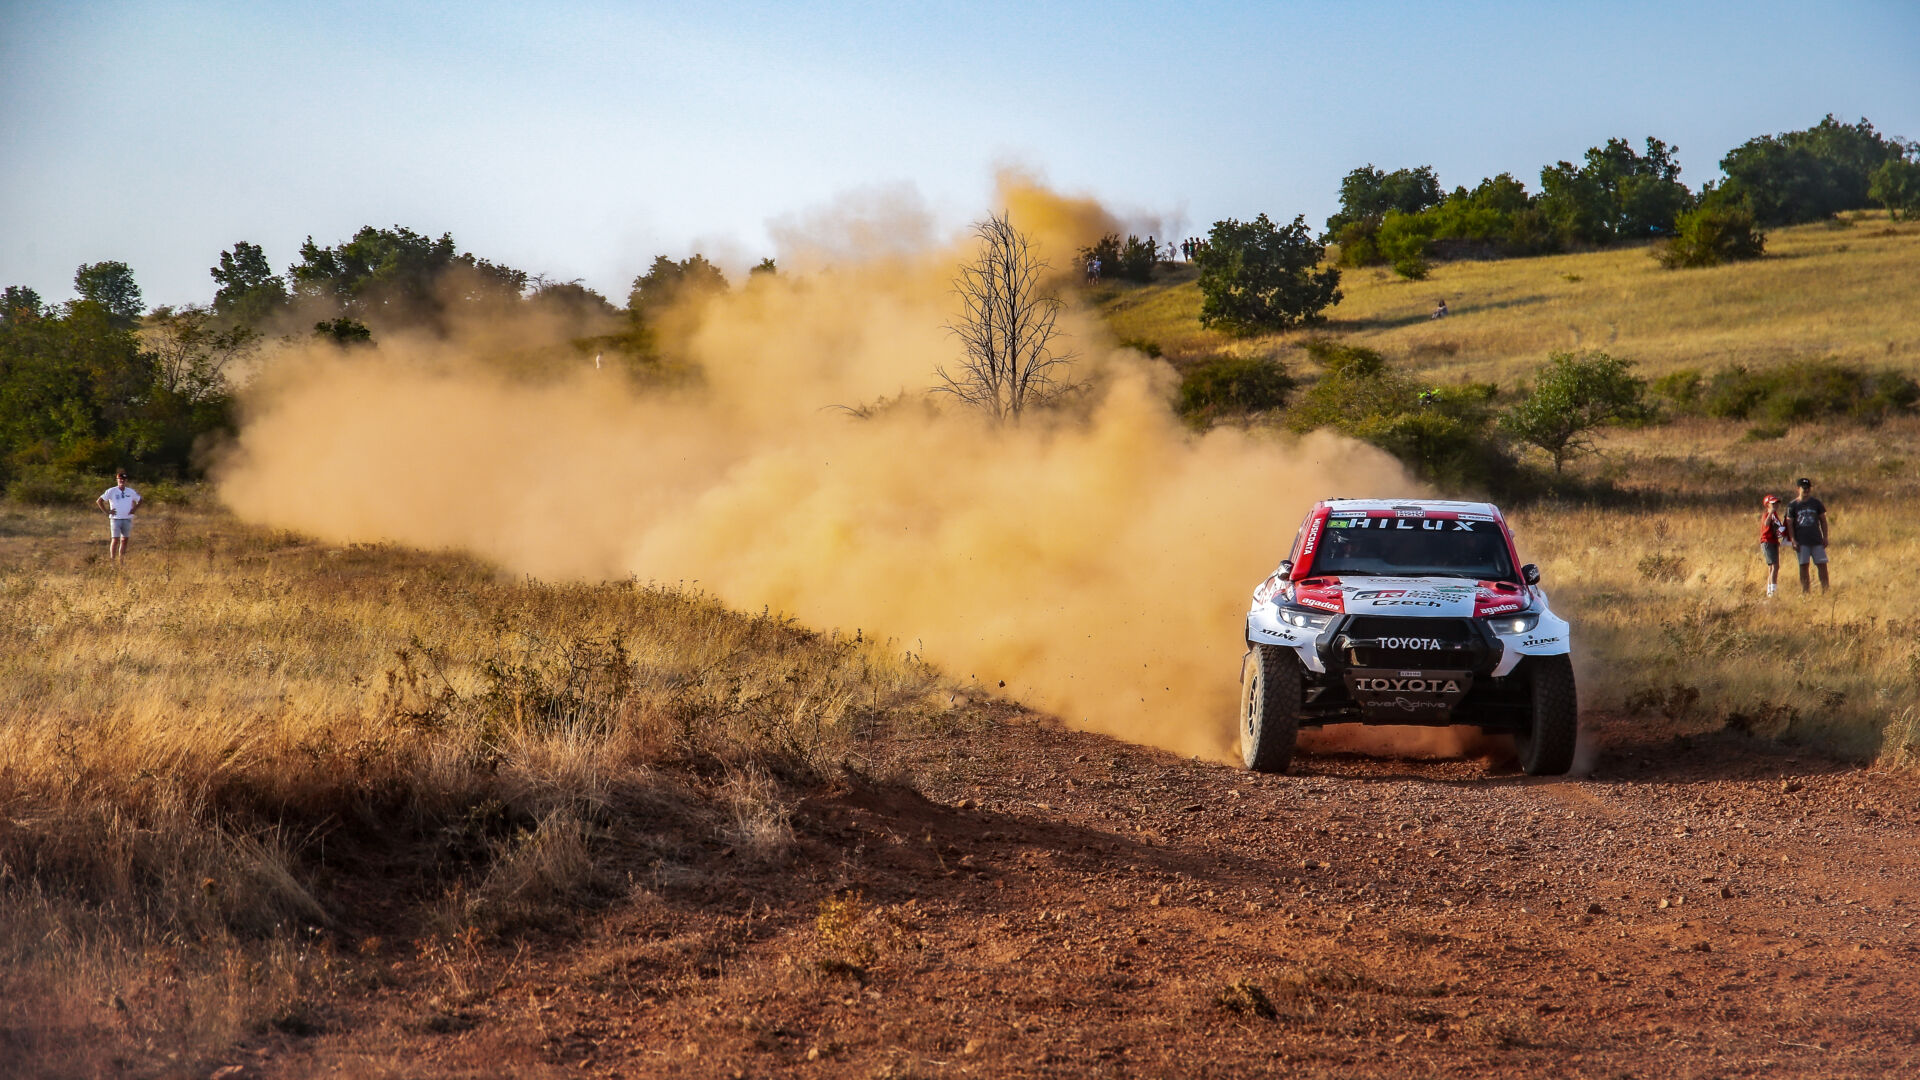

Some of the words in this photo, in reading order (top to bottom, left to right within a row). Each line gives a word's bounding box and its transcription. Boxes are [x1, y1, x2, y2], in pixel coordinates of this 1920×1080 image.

[1349, 518, 1476, 532] HILUX
[1304, 518, 1322, 556] MUSICDATA
[1301, 598, 1340, 611] agados
[1372, 599, 1441, 608] Czech
[1480, 603, 1519, 615] agados
[1259, 628, 1298, 642] XTLINE
[1379, 637, 1441, 650] TOYOTA
[1522, 637, 1560, 647] XTLINE
[1355, 679, 1461, 692] TOYOTA
